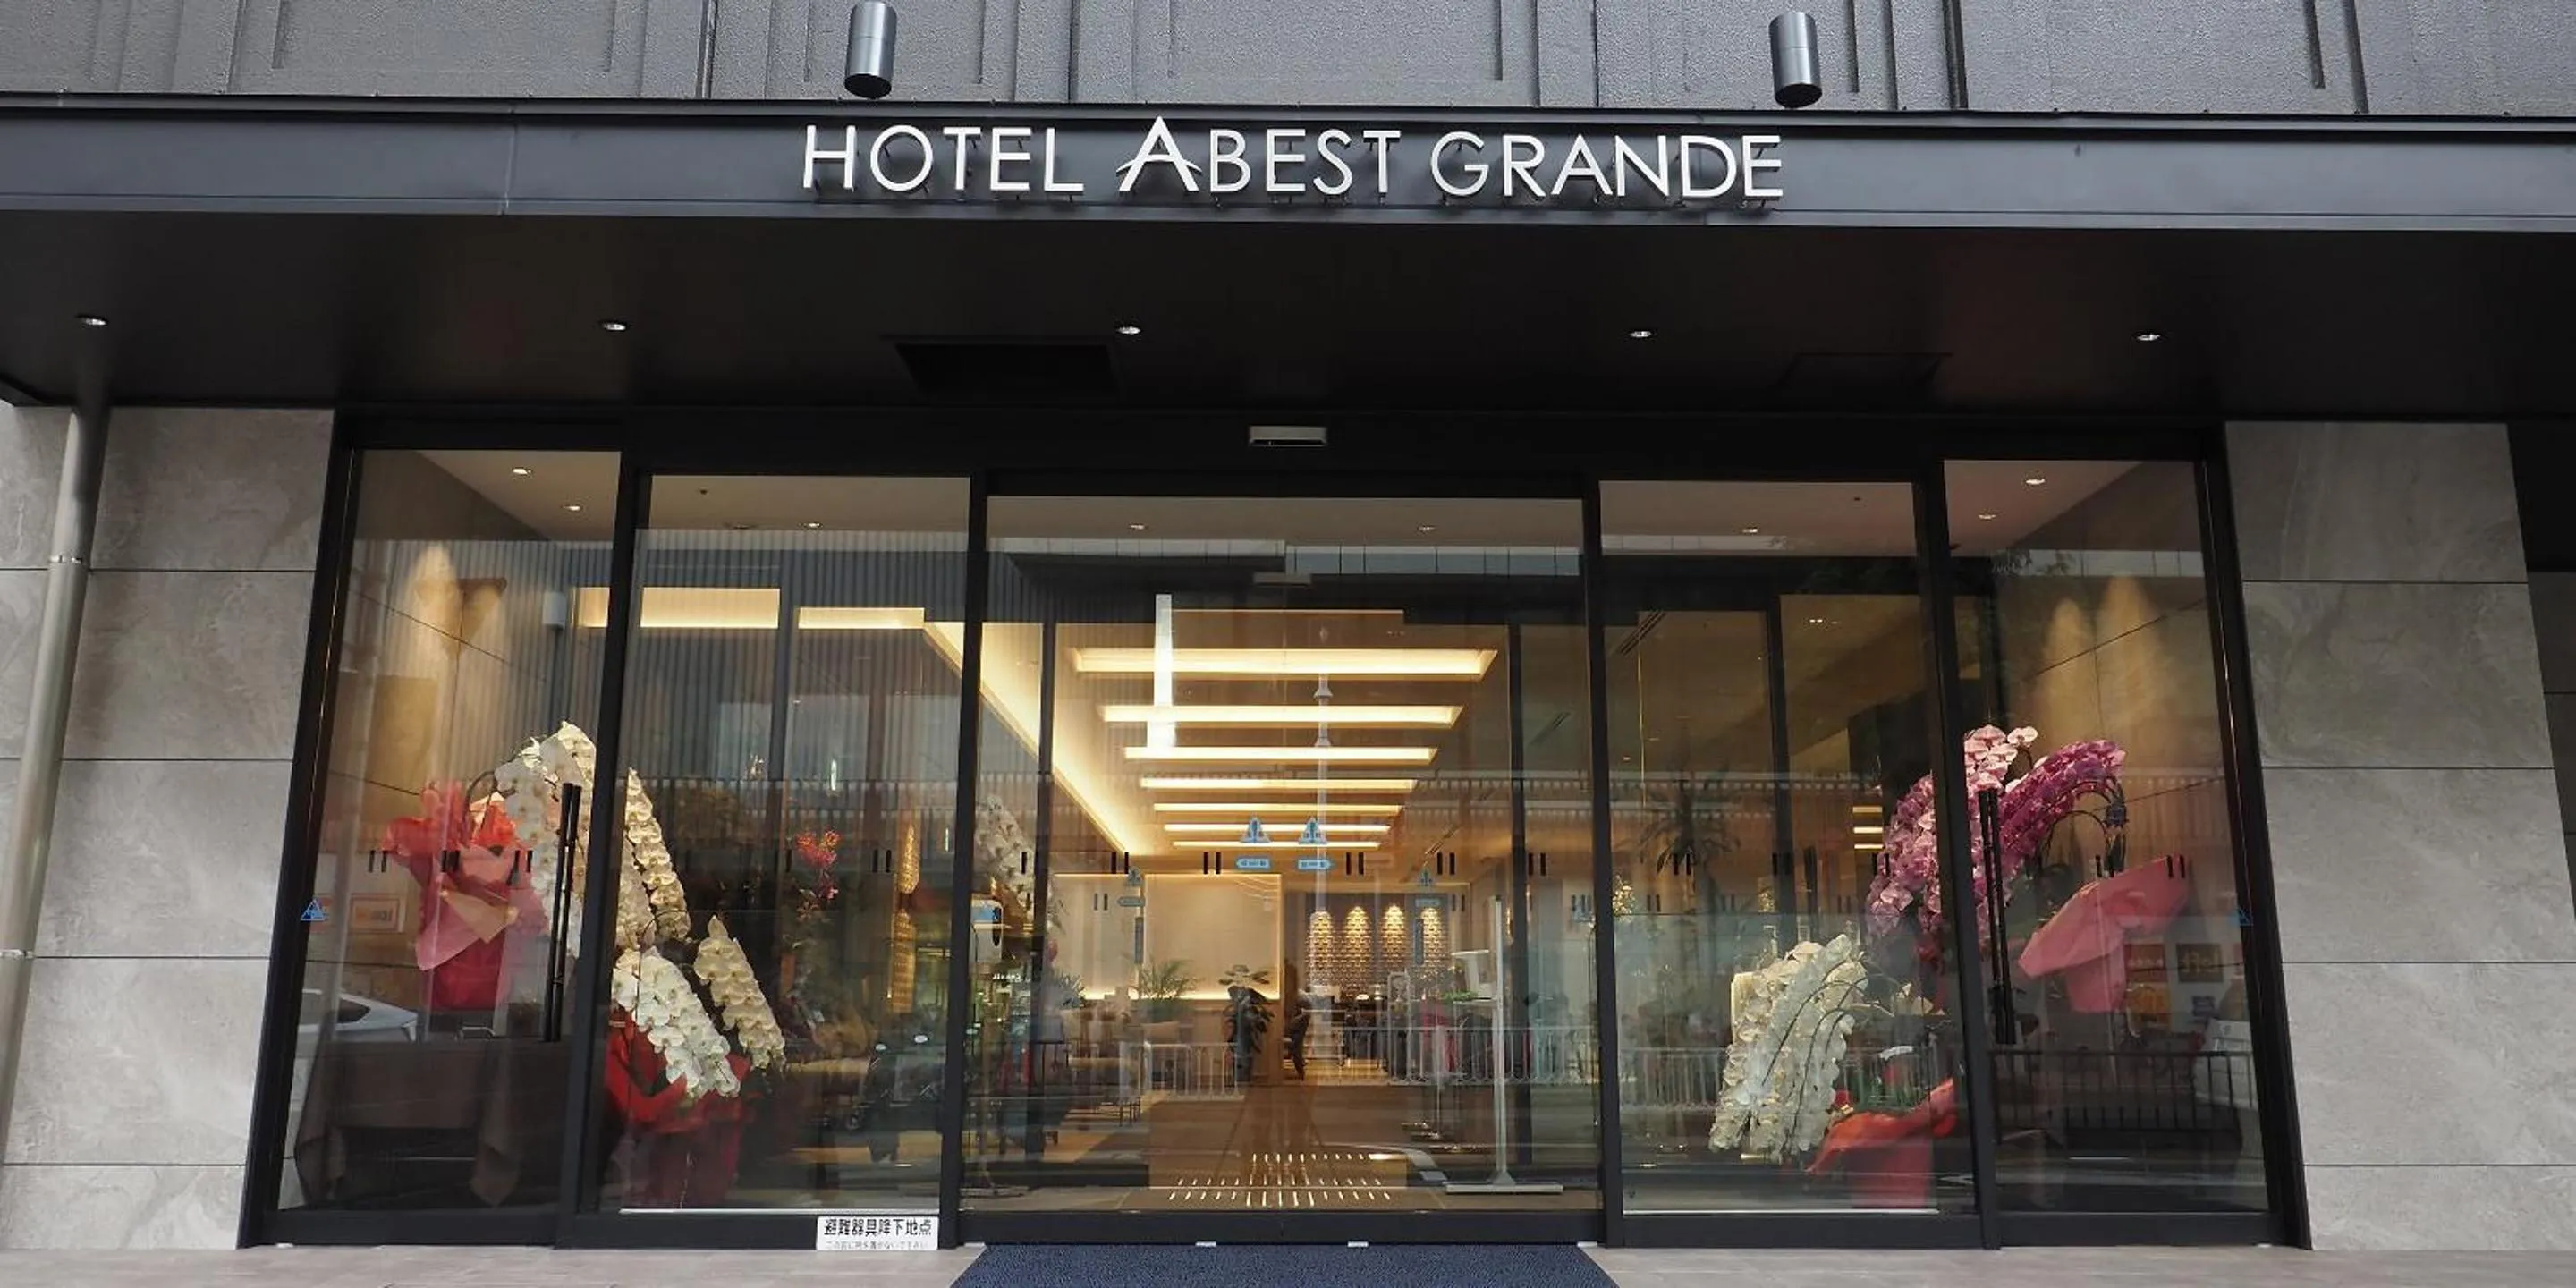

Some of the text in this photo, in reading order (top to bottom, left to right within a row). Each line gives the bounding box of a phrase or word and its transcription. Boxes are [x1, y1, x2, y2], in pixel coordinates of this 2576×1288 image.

[803, 116, 1784, 198] HOTEL ABEST GRANDE
[824, 1218, 932, 1236] 避難器具降下地点
